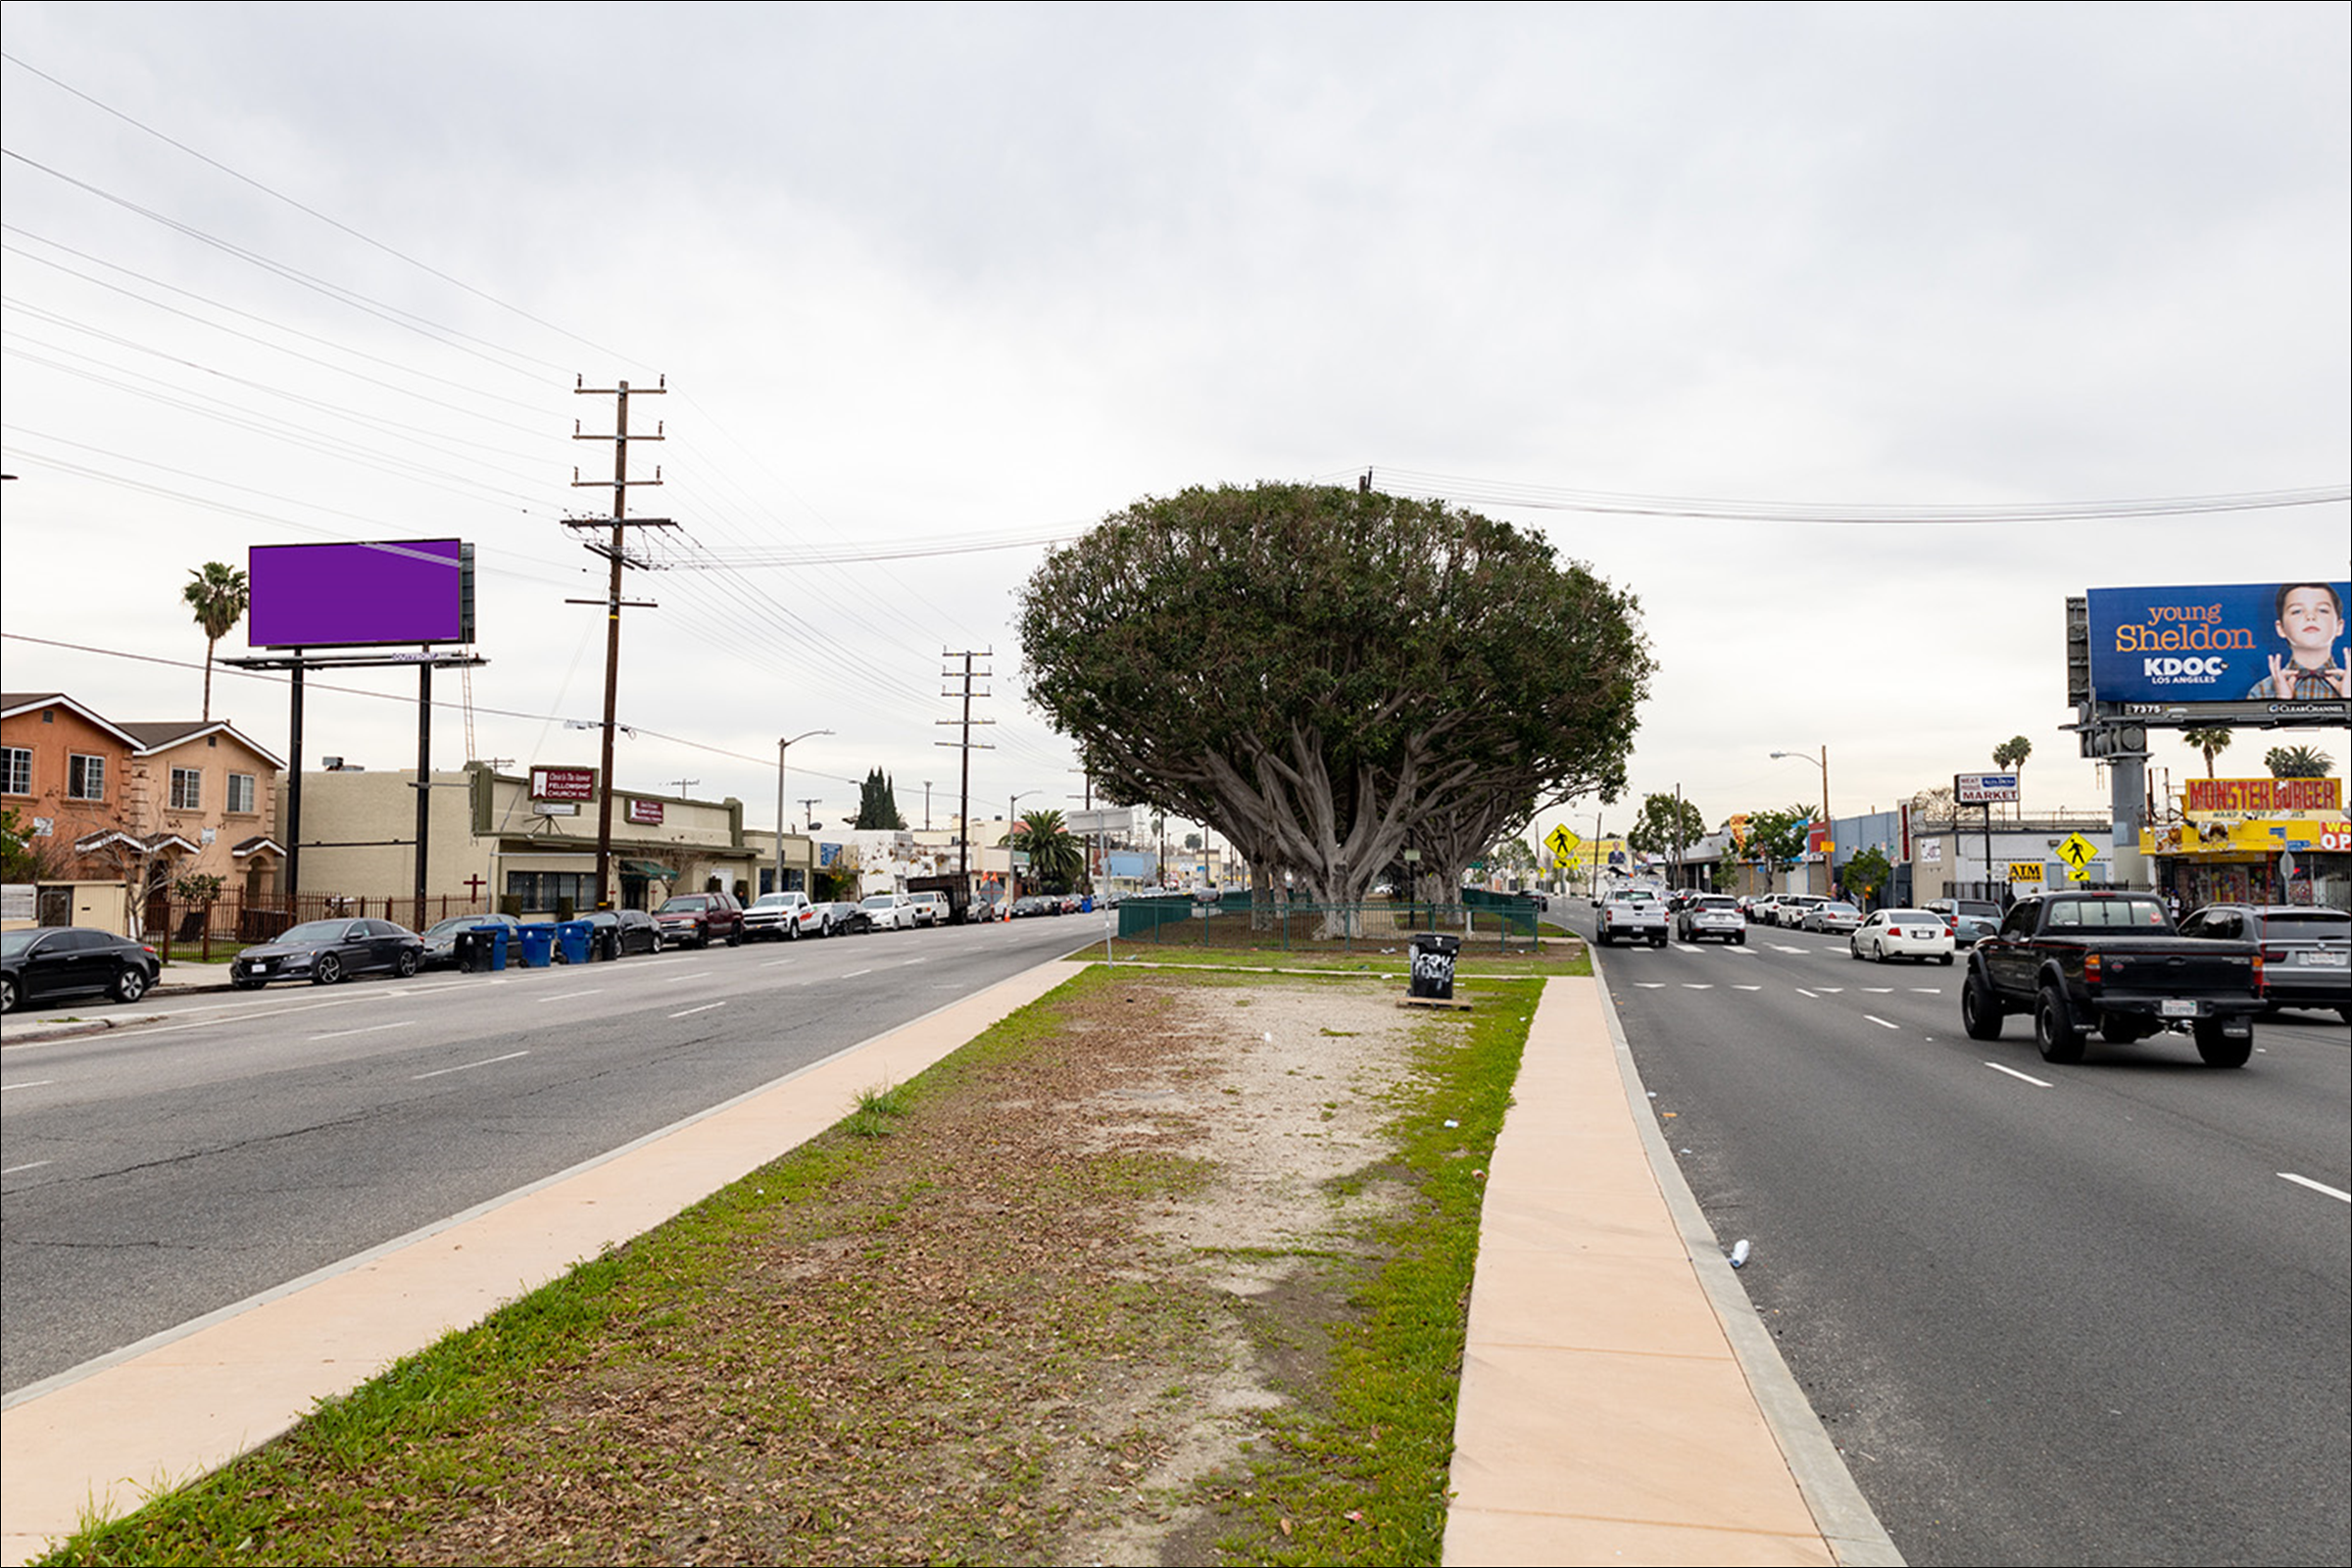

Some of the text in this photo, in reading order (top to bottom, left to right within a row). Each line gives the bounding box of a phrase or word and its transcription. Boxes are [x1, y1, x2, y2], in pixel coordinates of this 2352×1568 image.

[2147, 603, 2223, 626] young
[2116, 623, 2257, 653] Sheldon
[2143, 657, 2224, 677] KDOC
[2151, 675, 2217, 685] LOS ANGELES
[1962, 791, 2018, 800] MARKET
[2189, 780, 2336, 810] MONSTER BURGER
[2010, 865, 2040, 876] ATM
